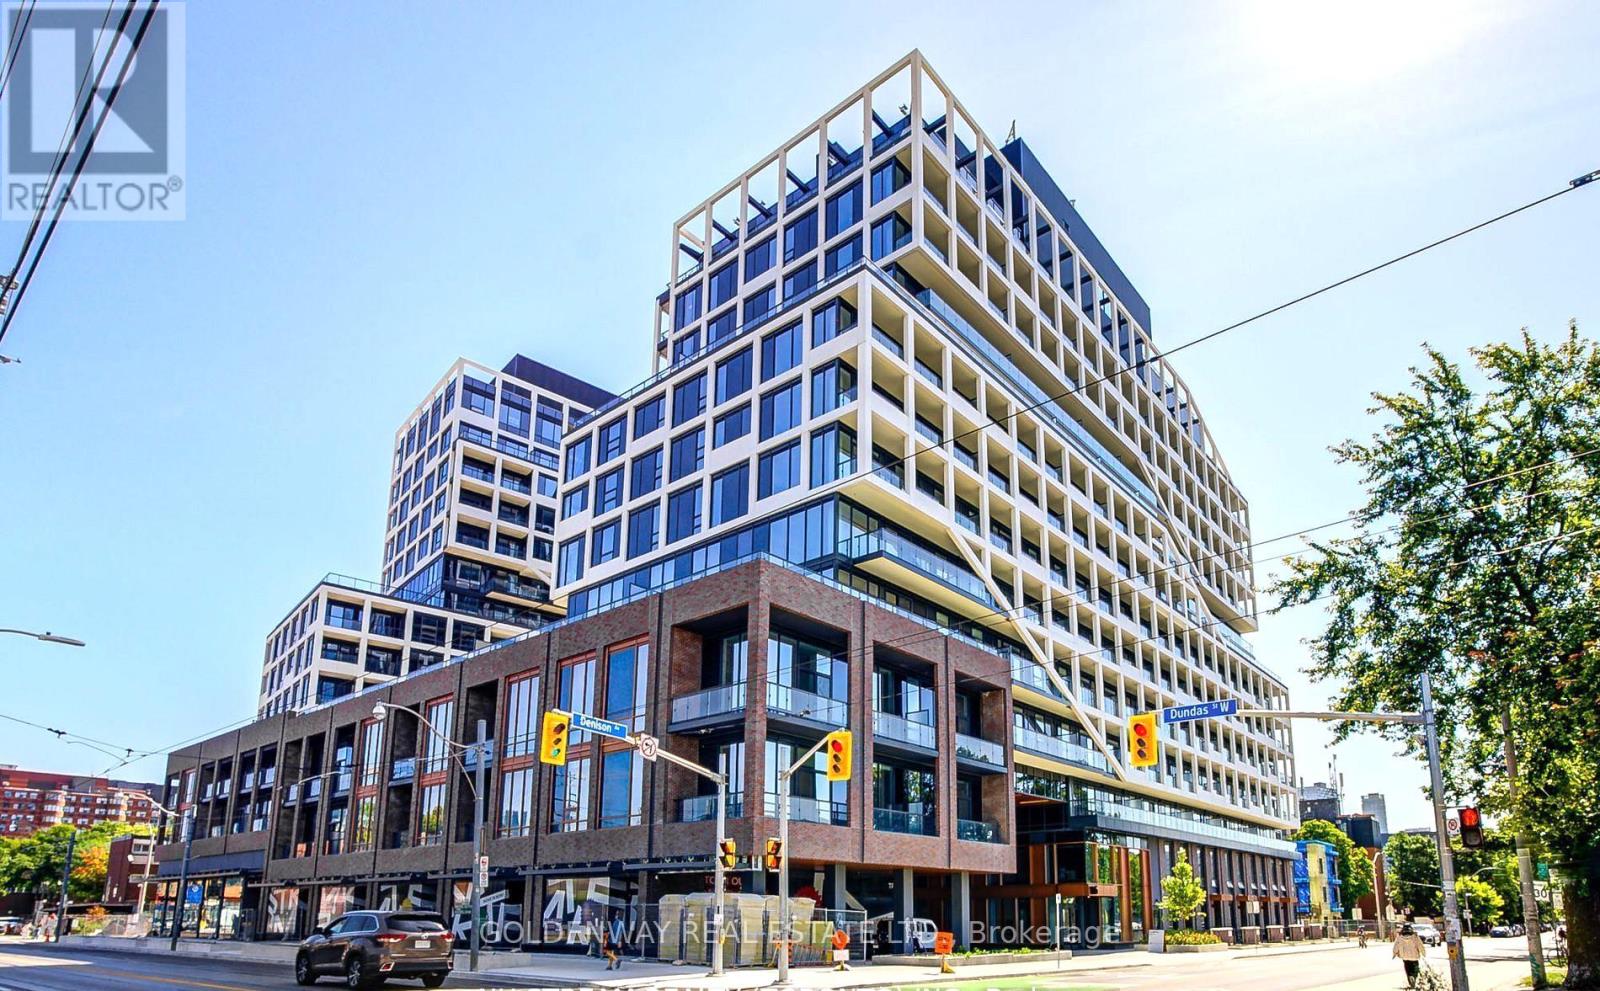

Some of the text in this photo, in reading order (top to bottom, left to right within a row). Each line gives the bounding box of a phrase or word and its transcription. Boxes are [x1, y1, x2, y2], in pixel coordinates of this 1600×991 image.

[1170, 706, 1208, 719] Dundas
[1220, 702, 1229, 712] W
[580, 715, 612, 733] Denison
